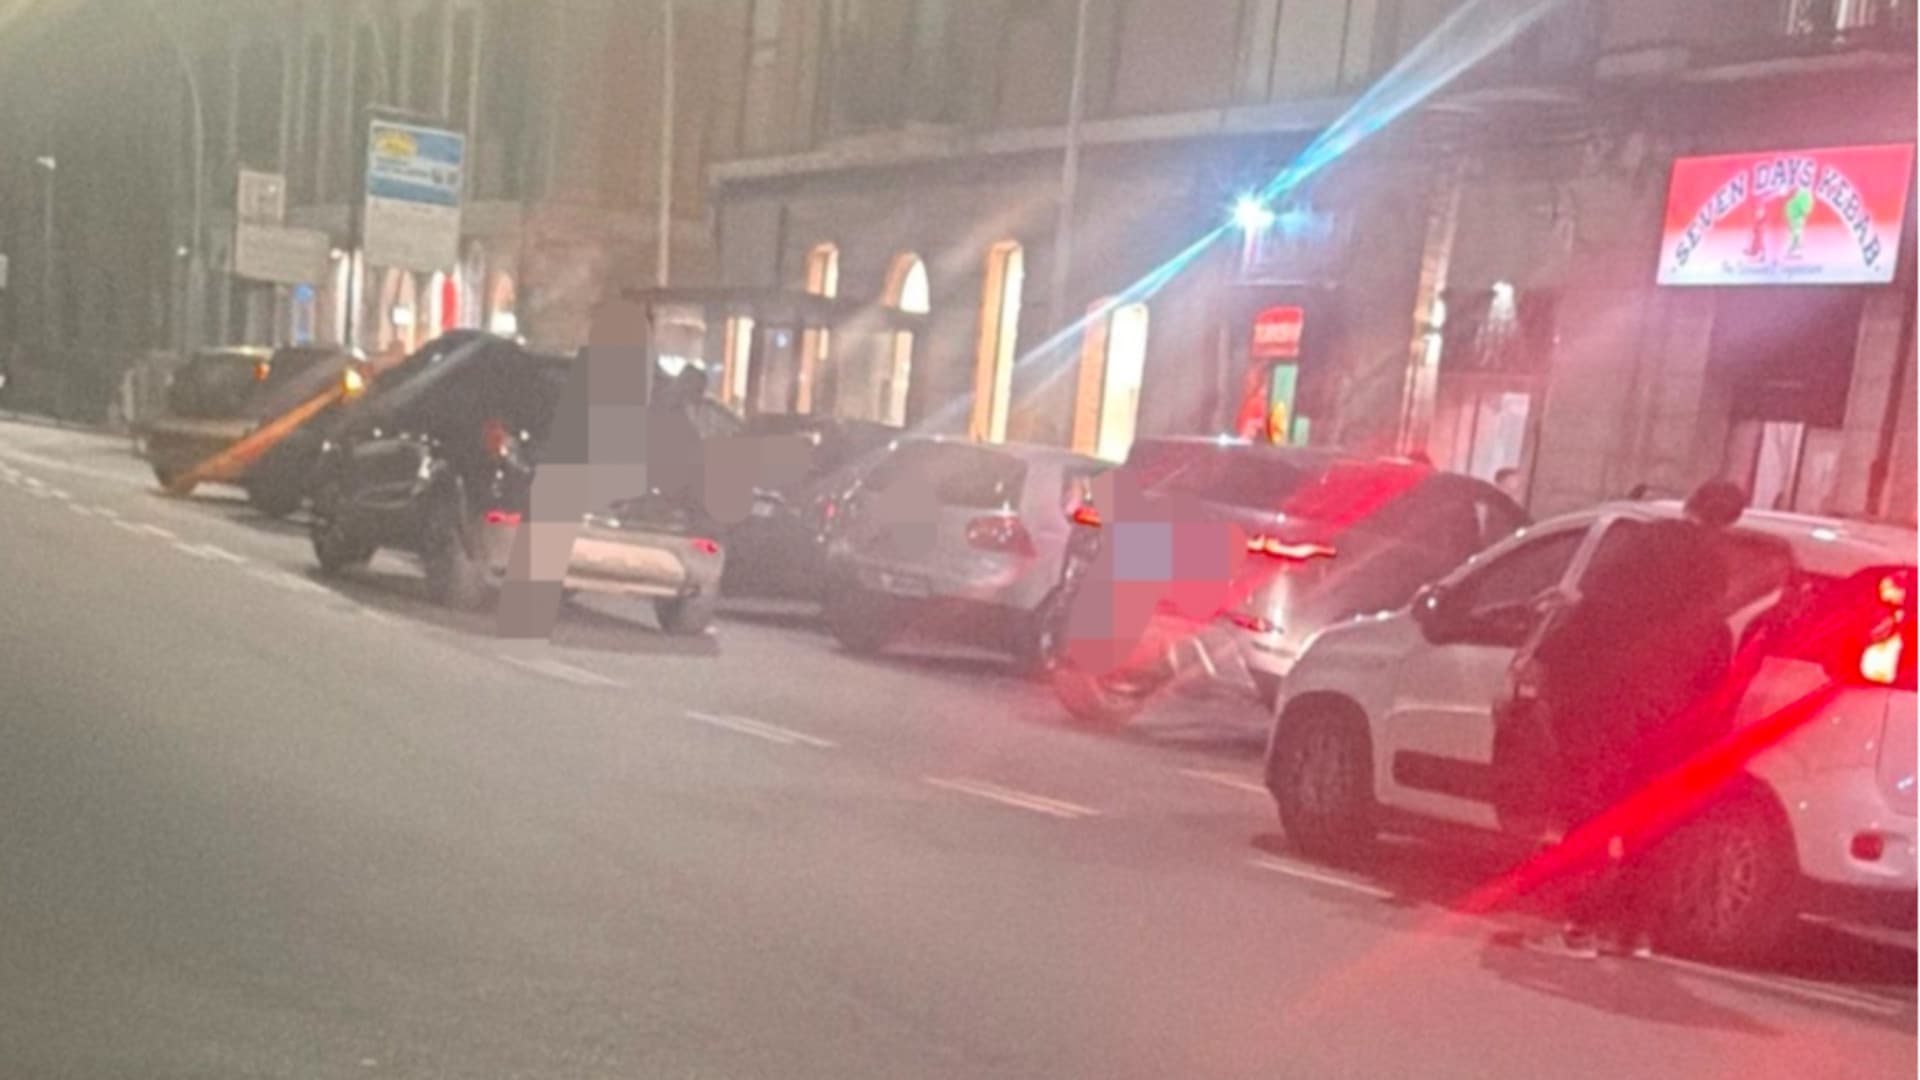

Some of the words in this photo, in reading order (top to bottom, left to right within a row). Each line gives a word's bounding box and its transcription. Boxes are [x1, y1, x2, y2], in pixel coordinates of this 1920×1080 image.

[1674, 174, 1746, 266] SEVEN
[1755, 158, 1815, 191] DAYS
[1818, 169, 1882, 266] KEBAB
